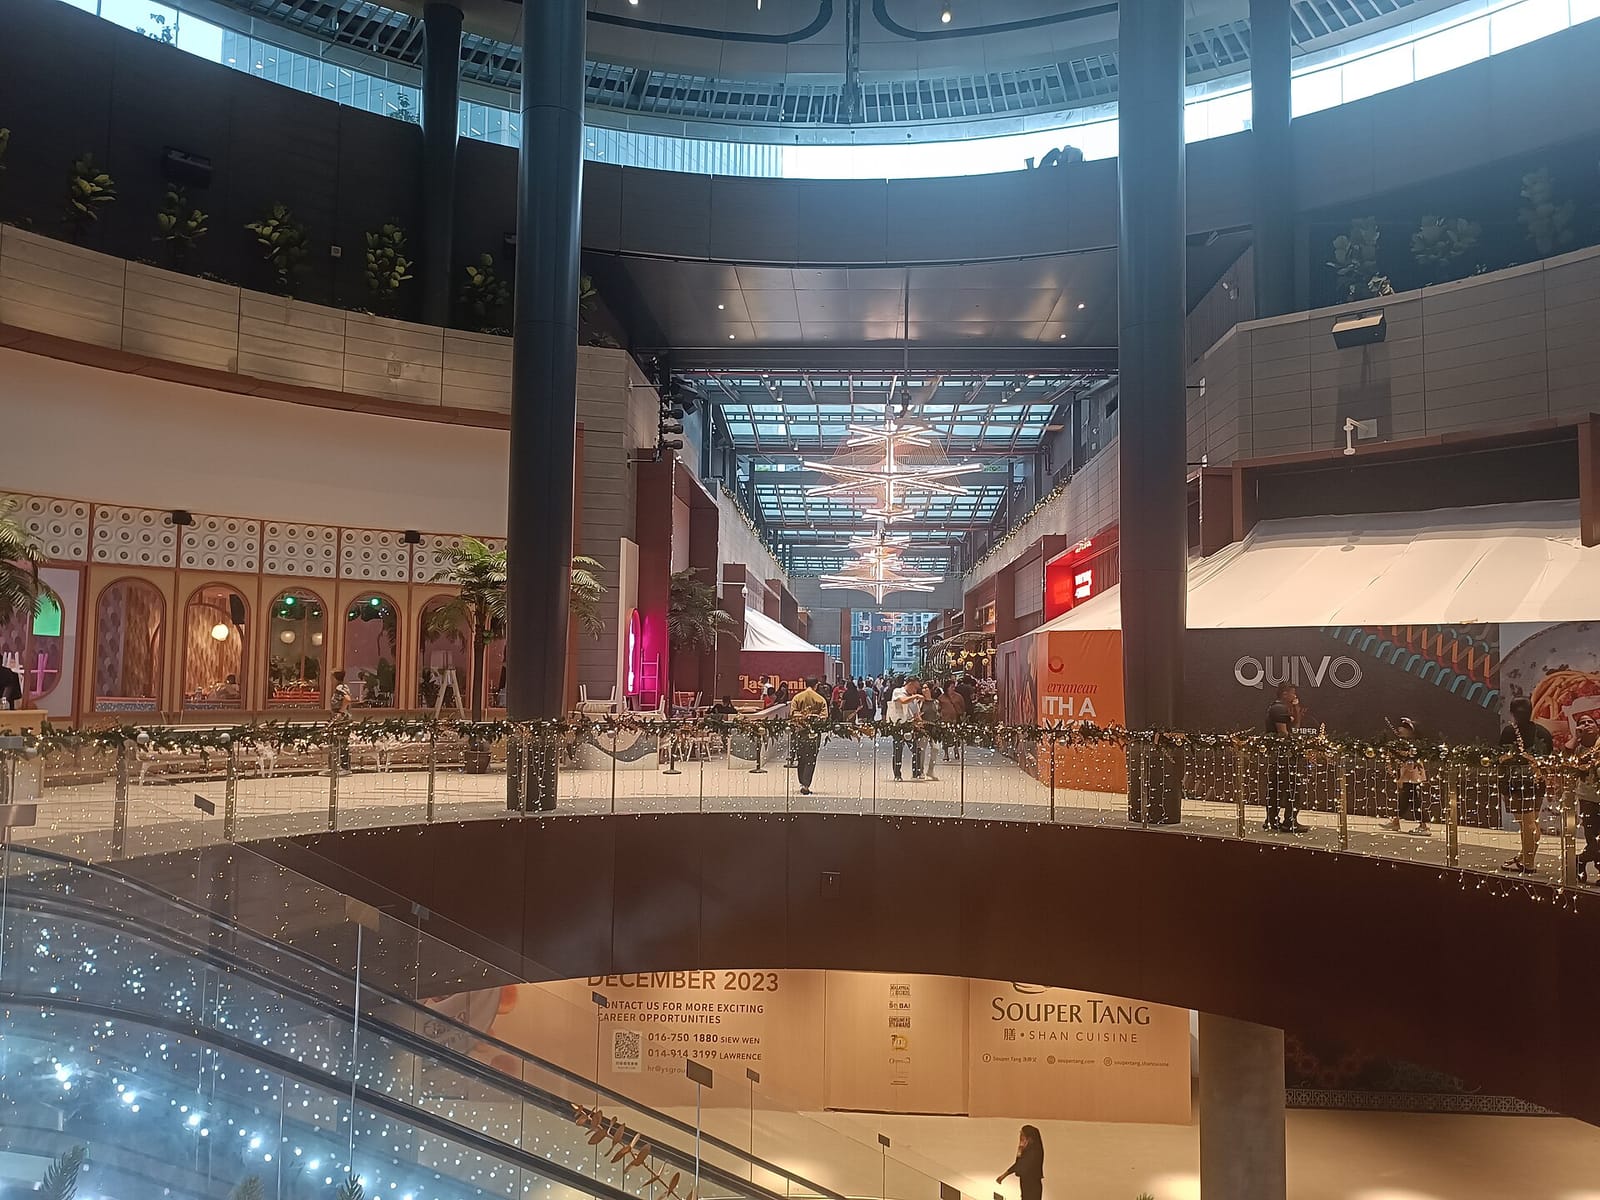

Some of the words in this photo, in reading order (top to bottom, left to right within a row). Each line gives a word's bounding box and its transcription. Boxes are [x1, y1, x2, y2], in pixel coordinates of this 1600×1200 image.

[1234, 655, 1363, 690] QUIVO
[1078, 697, 1097, 718] A
[587, 971, 716, 990] DECEMBER
[723, 971, 779, 992] 2023
[599, 1001, 644, 1011] ONTACT
[646, 1002, 660, 1011] US
[662, 1002, 682, 1011] FOR
[685, 1003, 714, 1012] MORE
[717, 1004, 764, 1014] EXCITING
[599, 1013, 636, 1022] CAREER
[639, 1013, 721, 1024] OPPORTUNITIES
[648, 1033, 690, 1042] 016-750
[693, 1034, 718, 1043] 1880
[720, 1036, 740, 1044] SIEW
[1029, 1030, 1069, 1041] SHAN
[1075, 1032, 1138, 1043] CUISINE
[648, 1049, 689, 1058] 014-914
[692, 1050, 717, 1060] 3199
[719, 1052, 762, 1061] LAWRENCE
